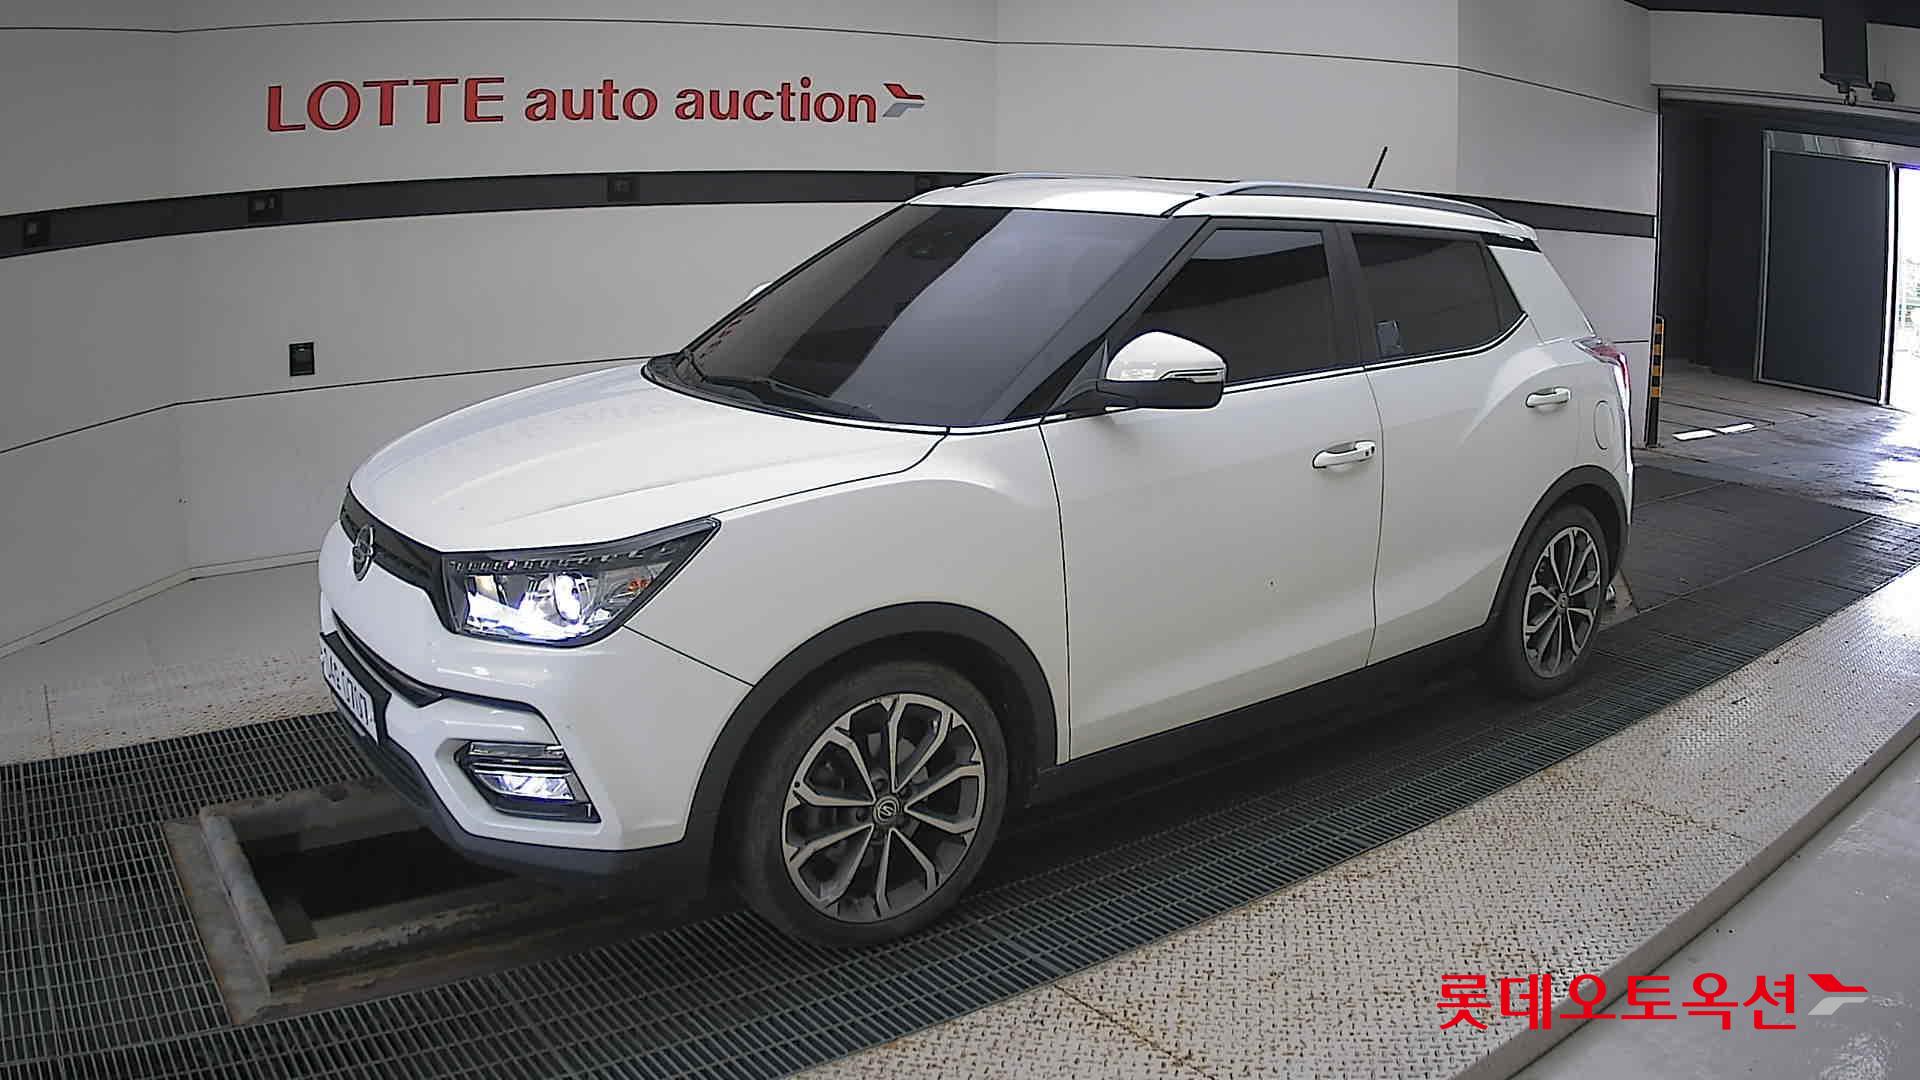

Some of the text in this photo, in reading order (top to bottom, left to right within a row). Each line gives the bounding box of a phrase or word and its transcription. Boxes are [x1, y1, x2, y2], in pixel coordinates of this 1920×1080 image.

[267, 77, 877, 132] LOTTE auto auction
